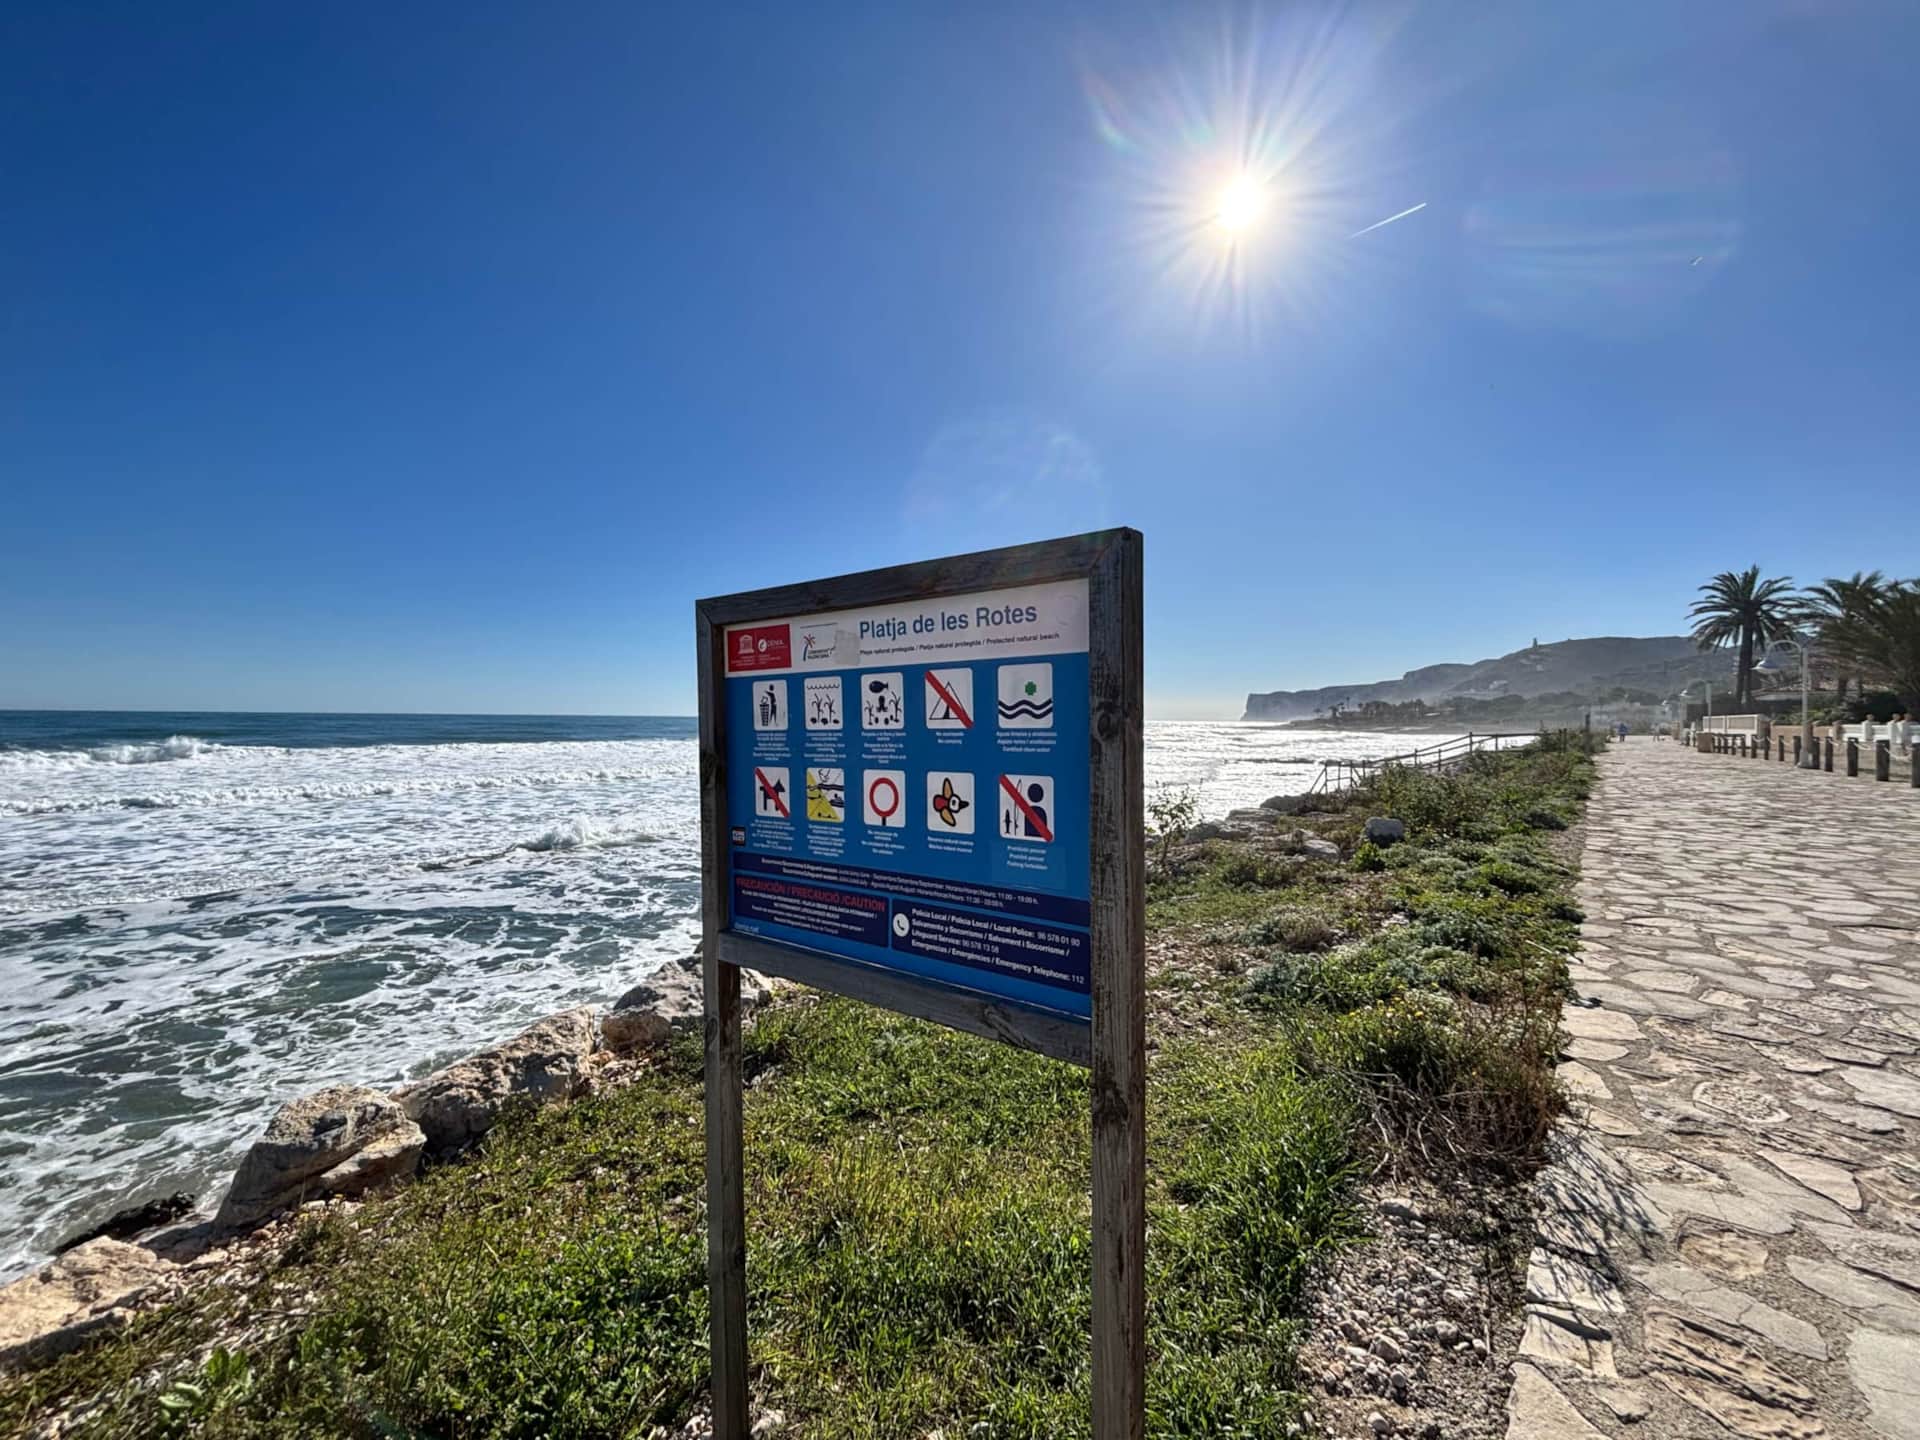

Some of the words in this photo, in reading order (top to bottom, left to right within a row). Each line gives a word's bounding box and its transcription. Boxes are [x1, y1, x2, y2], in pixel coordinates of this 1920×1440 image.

[860, 617, 907, 641] Platja
[912, 614, 935, 634] de
[941, 611, 969, 631] les
[976, 605, 1038, 628] Rotes
[994, 923, 1012, 933] Local
[996, 957, 1032, 974] Emergency
[1072, 975, 1085, 984] 112
